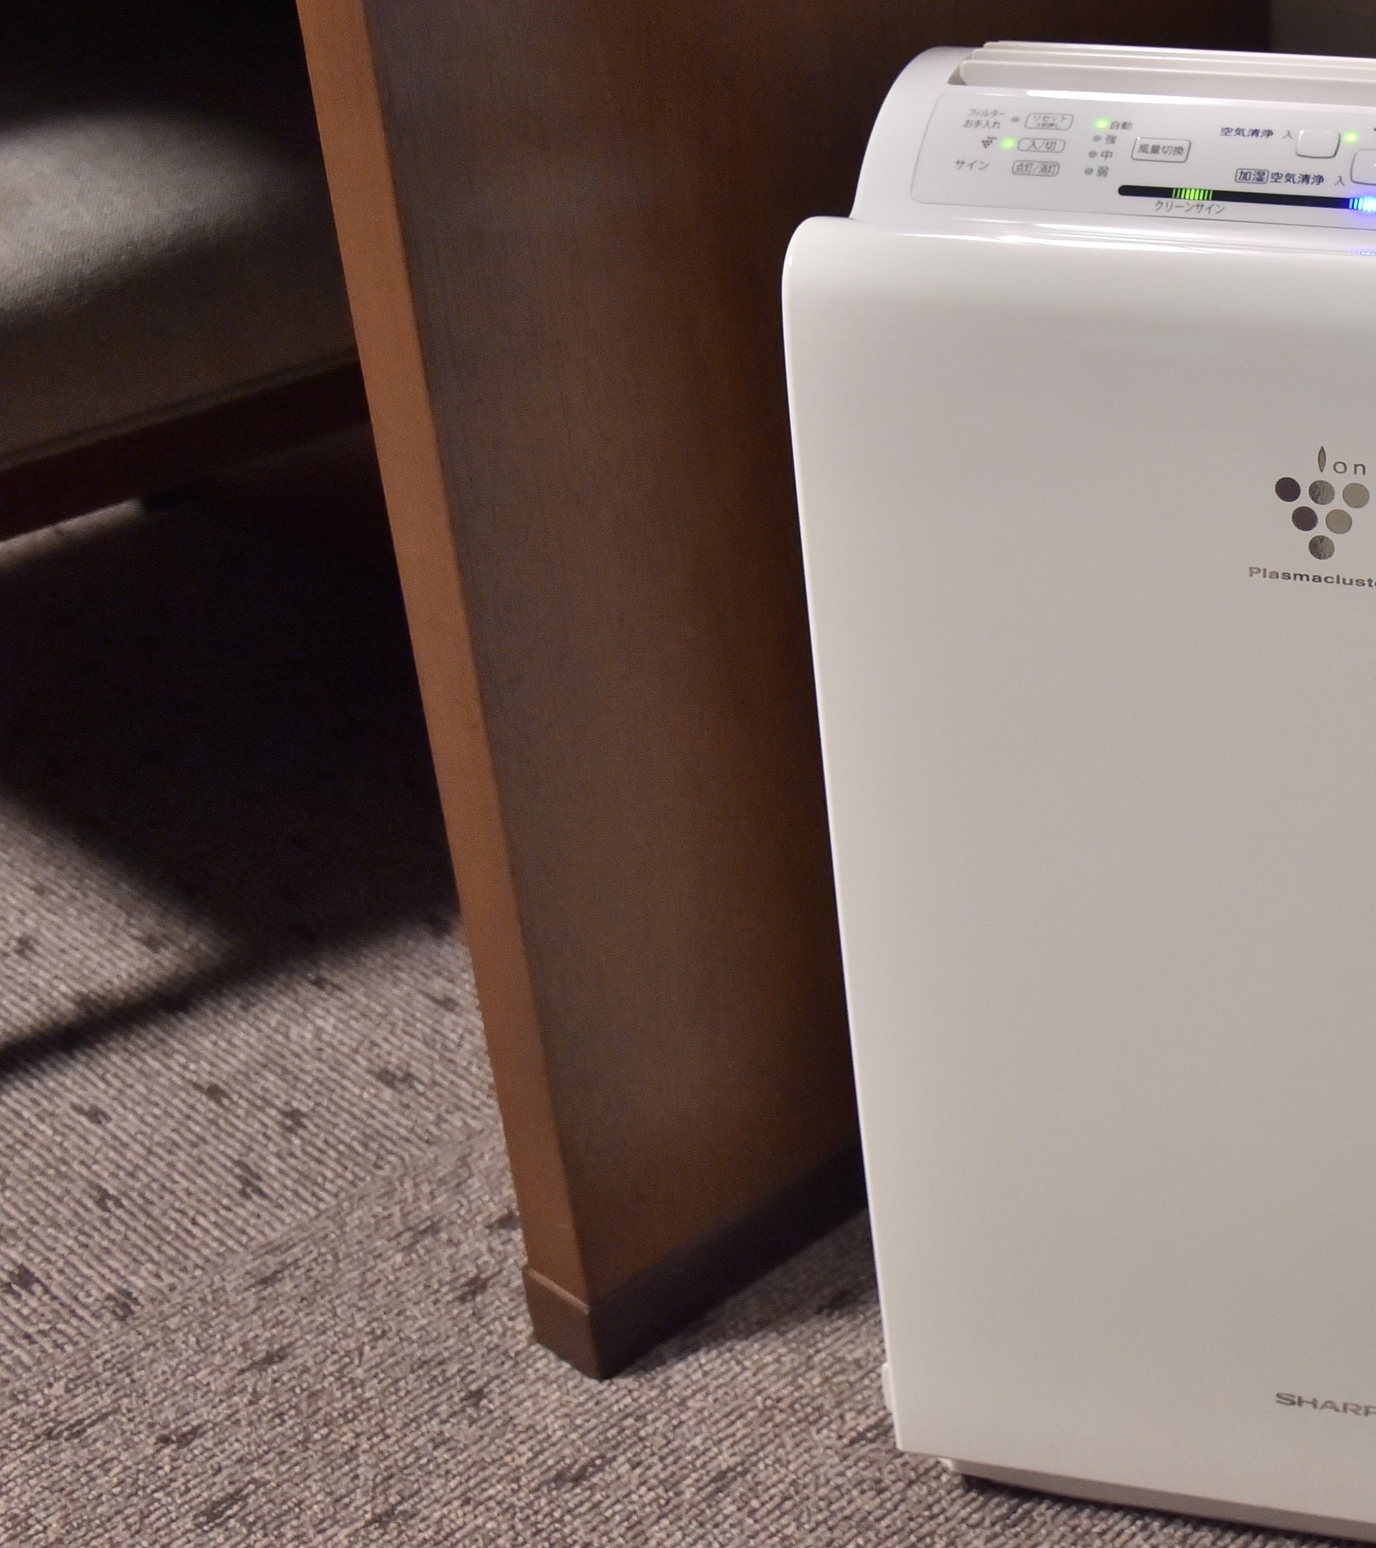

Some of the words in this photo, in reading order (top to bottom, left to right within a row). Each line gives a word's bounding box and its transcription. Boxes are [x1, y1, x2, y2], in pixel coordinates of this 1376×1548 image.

[963, 119, 1001, 130] お手入れ
[1110, 120, 1133, 131] 自動
[1220, 126, 1274, 138] 空気清浄
[1283, 130, 1294, 140] 入
[1027, 139, 1057, 151] 入/切
[1104, 135, 1118, 145] 強
[1100, 150, 1113, 161] 中
[1137, 143, 1185, 156] 風量切換
[955, 159, 990, 171] サイン
[1096, 165, 1110, 178] 弱
[1334, 176, 1346, 187] 入
[1154, 200, 1226, 215] クリーンサイン
